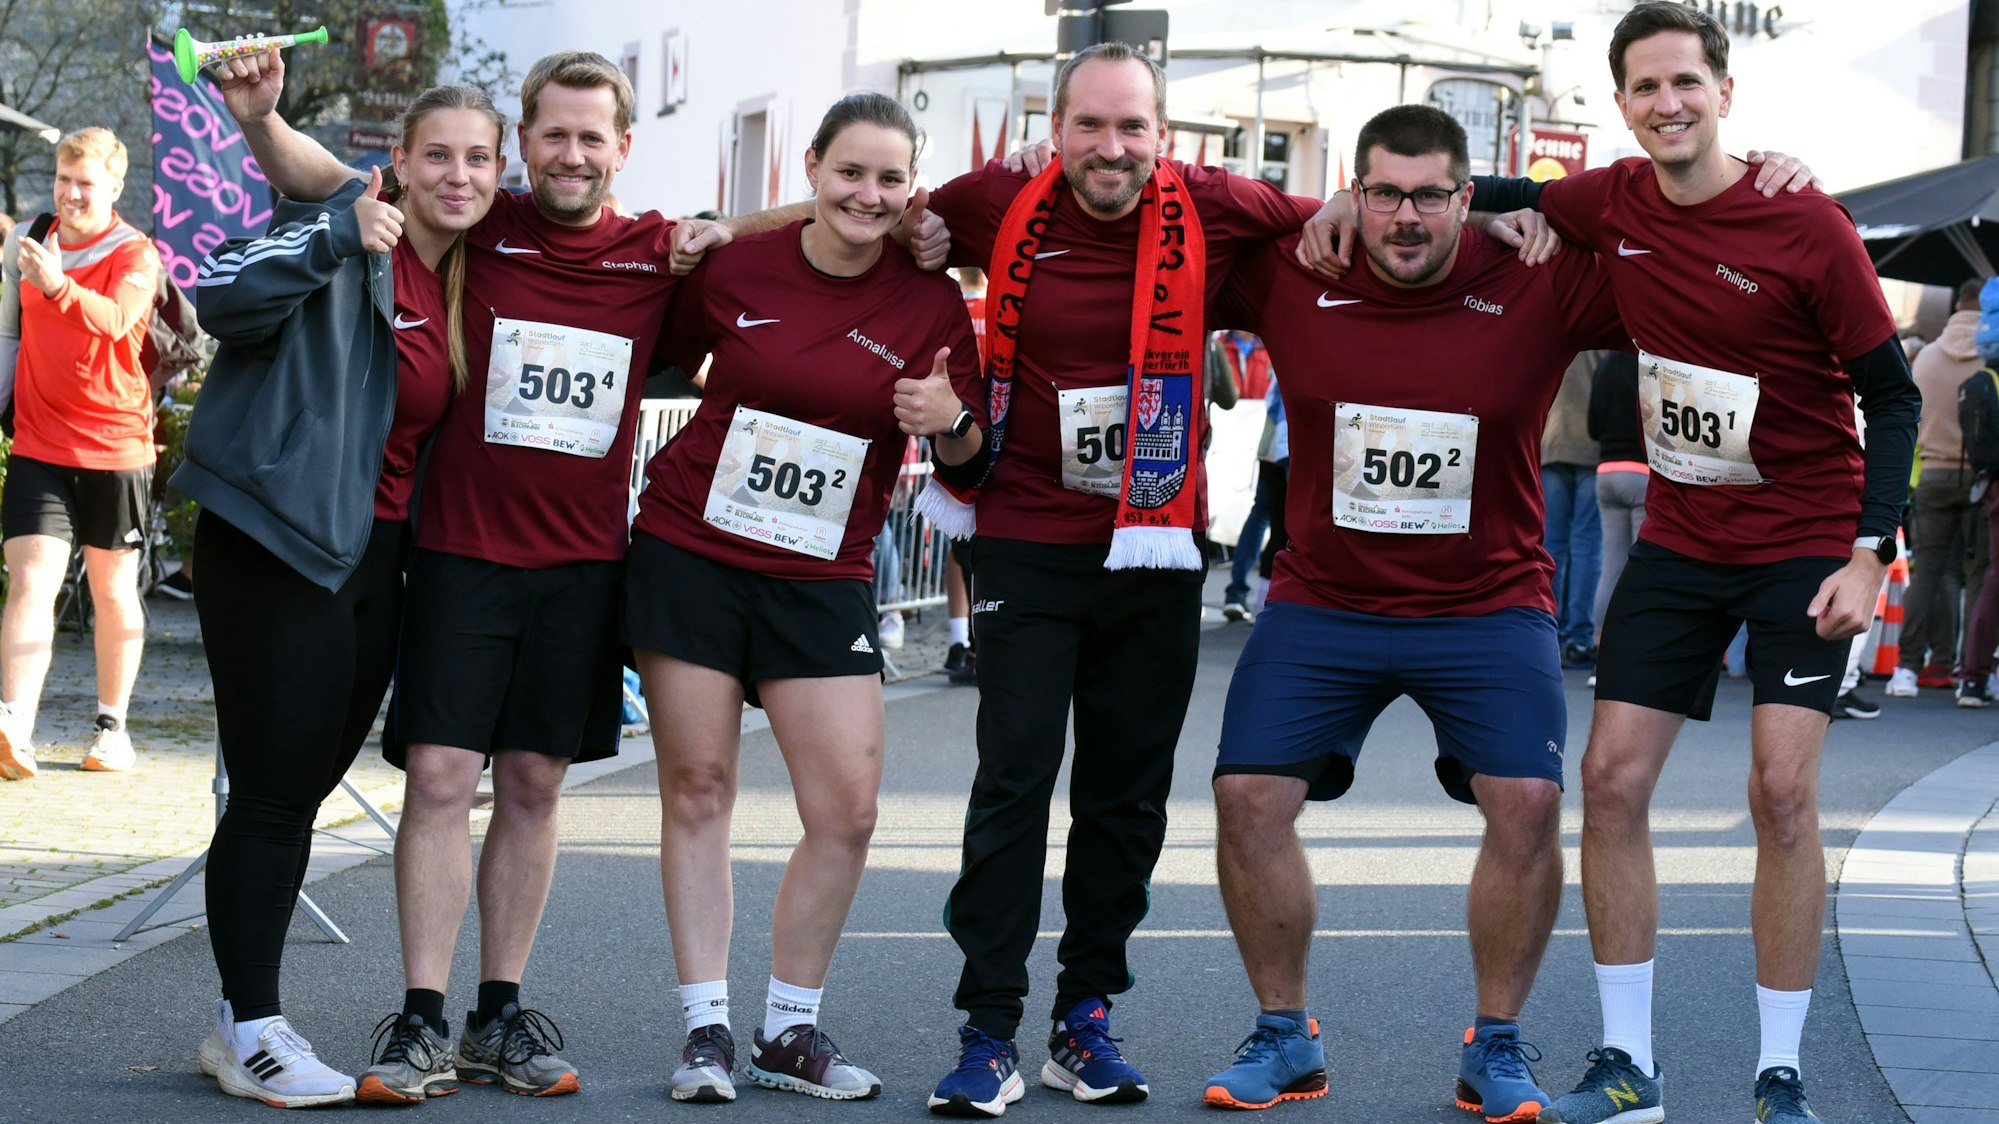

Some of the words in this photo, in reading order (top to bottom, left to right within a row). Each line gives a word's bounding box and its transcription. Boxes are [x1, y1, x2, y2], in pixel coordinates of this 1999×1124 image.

[602, 260, 657, 273] Stephan
[1716, 263, 1759, 294] Philipp
[1464, 295, 1504, 315] Tobias
[528, 330, 566, 341] Stadtlauf
[847, 328, 905, 370] Annaluisa
[1094, 394, 1127, 403] Stadtlau
[1369, 414, 1407, 424] Stadtlauf
[765, 421, 802, 436] Stadtlauf
[492, 431, 509, 440] AOK
[521, 434, 550, 445] VOSS
[553, 439, 576, 450] BEW
[1077, 423, 1126, 464] 50
[1670, 469, 1694, 481] VOSS
[1696, 475, 1718, 483] BEW
[711, 515, 732, 527] AOK
[1340, 514, 1358, 524] AOK
[1368, 519, 1398, 529] VOSS
[743, 524, 772, 539] VOSS
[1400, 521, 1425, 530] BEW
[774, 533, 799, 546] BEW
[810, 543, 831, 555] Helios
[771, 1002, 814, 1014] adidas
